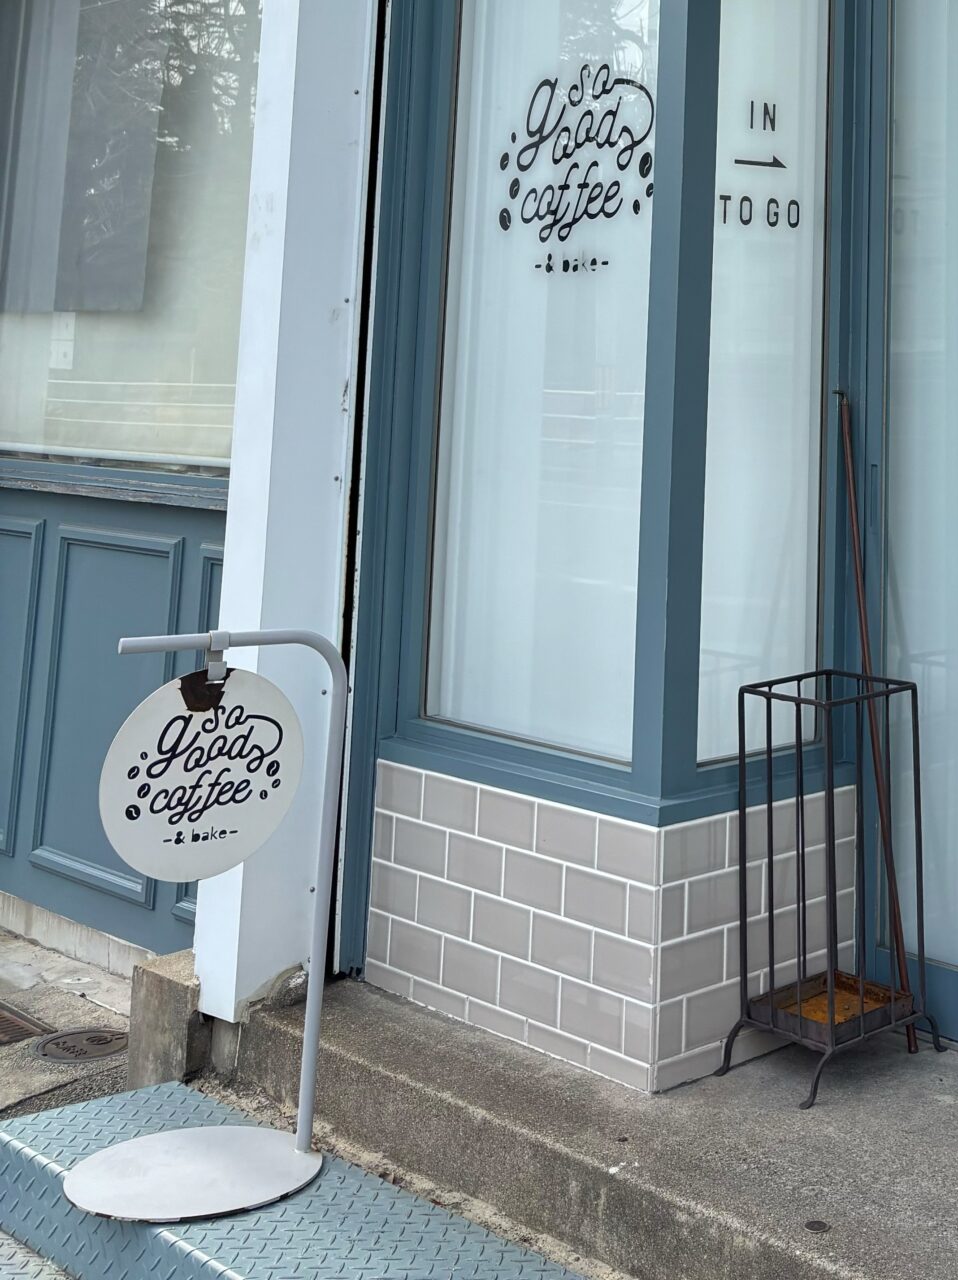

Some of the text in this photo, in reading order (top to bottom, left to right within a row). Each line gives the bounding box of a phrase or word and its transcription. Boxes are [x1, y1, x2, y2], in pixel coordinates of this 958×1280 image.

[568, 63, 612, 107] so
[516, 77, 654, 172] good
[749, 100, 777, 132] IN
[520, 160, 624, 243] coffee
[718, 194, 801, 229] TO GO
[201, 704, 245, 734] so
[146, 713, 283, 779] good
[149, 767, 254, 826] coffee
